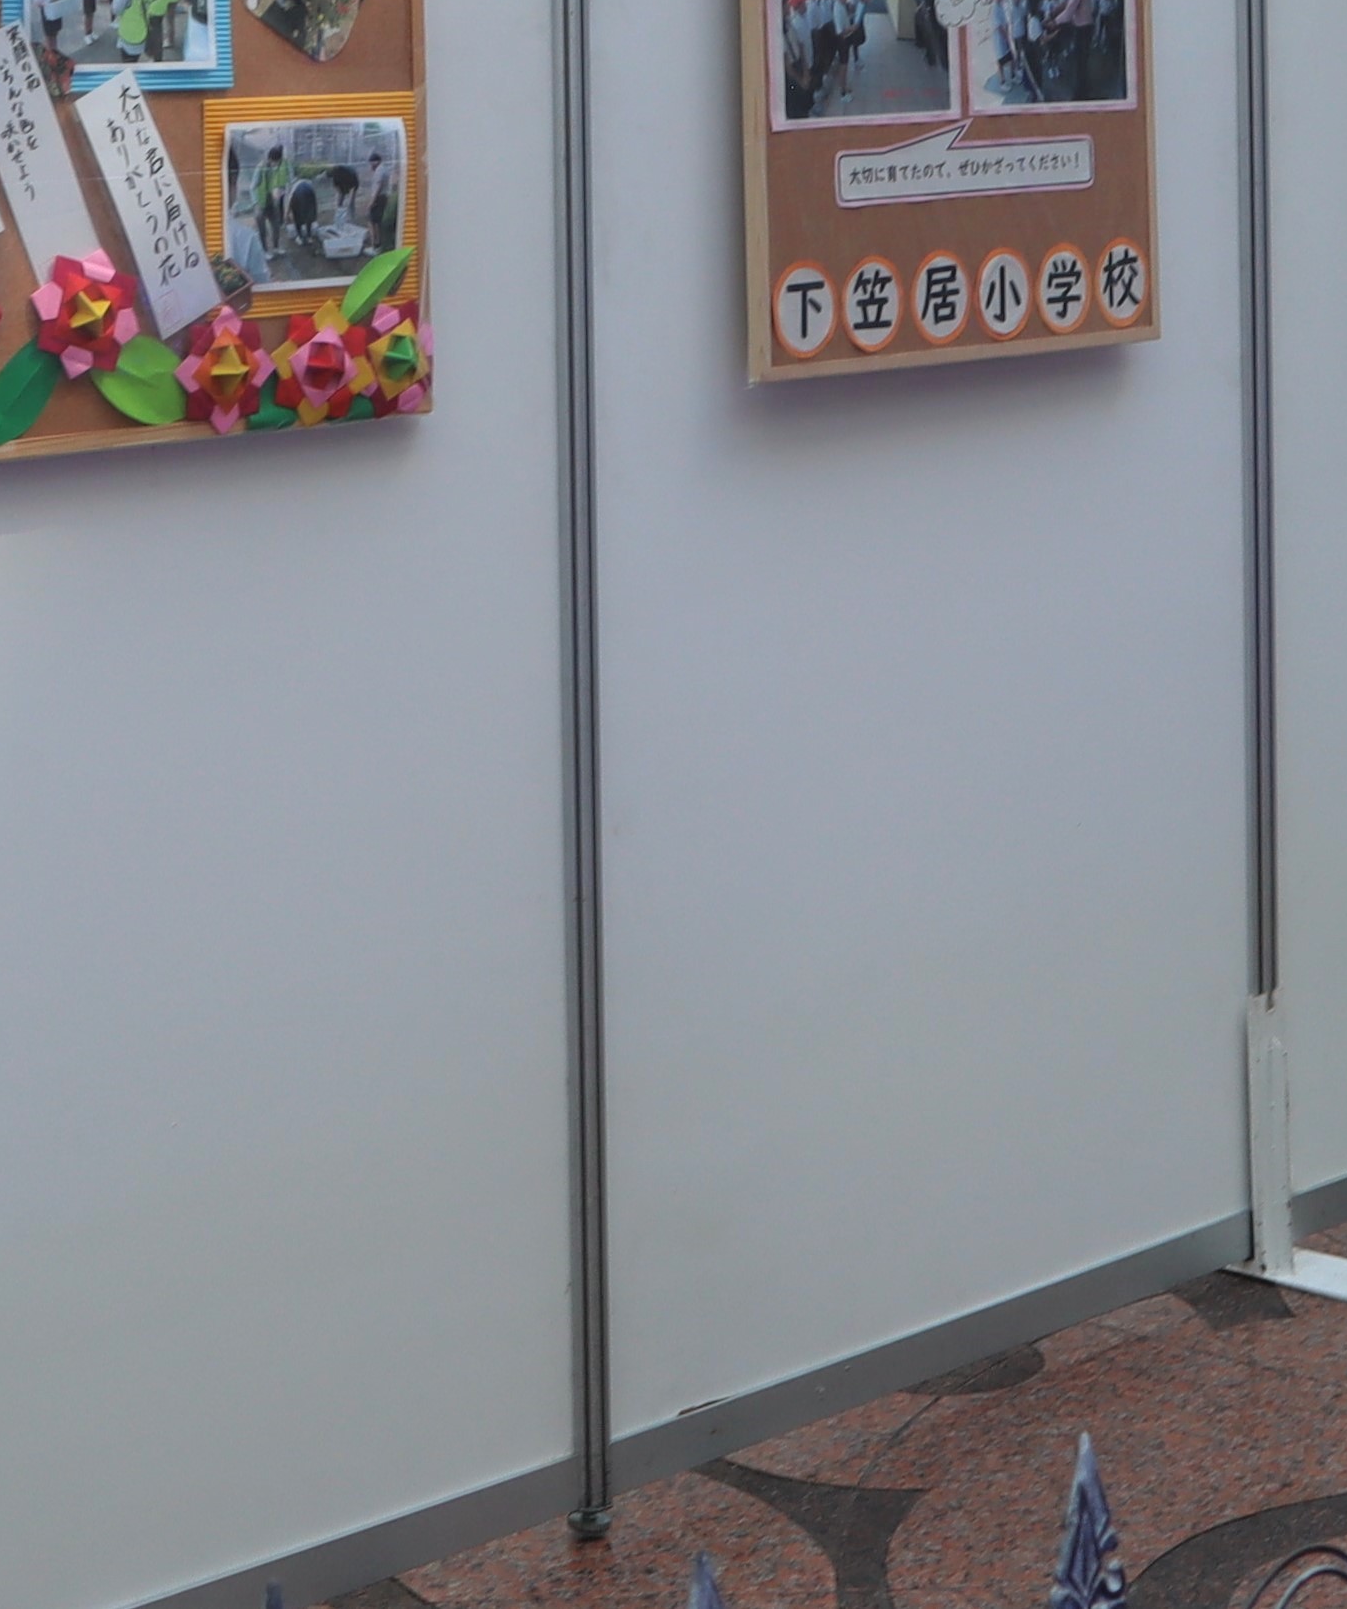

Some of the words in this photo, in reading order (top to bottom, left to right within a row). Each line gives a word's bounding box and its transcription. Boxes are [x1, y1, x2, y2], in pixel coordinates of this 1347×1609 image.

[107, 120, 180, 287] ありがとうの花
[785, 247, 1141, 339] 下笠居小学校
